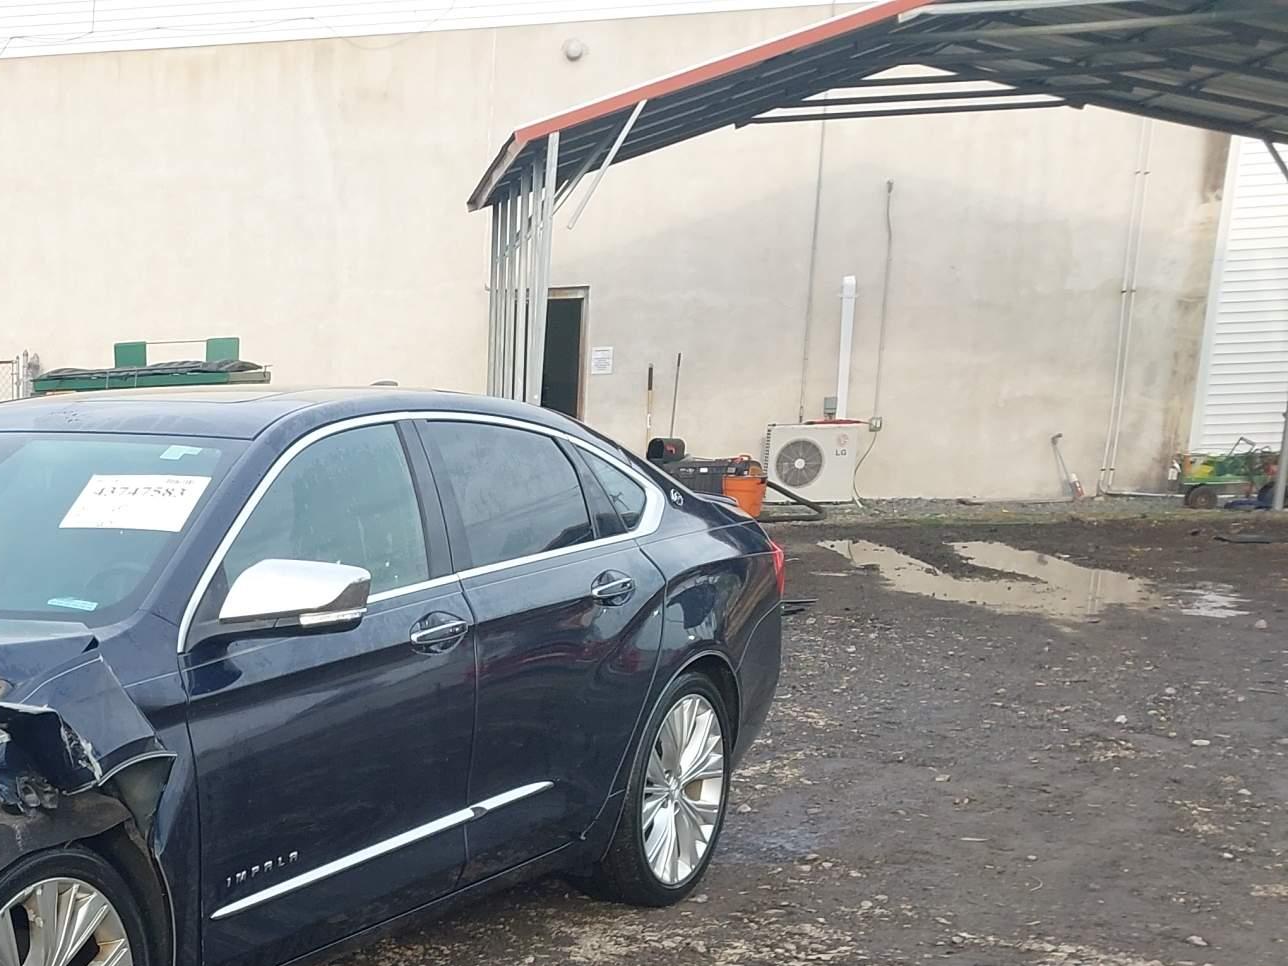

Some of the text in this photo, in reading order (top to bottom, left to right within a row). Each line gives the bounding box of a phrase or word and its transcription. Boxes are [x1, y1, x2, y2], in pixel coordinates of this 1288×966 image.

[835, 448, 847, 456] LG
[94, 486, 188, 498] 43747583
[226, 850, 298, 888] IMPALA
